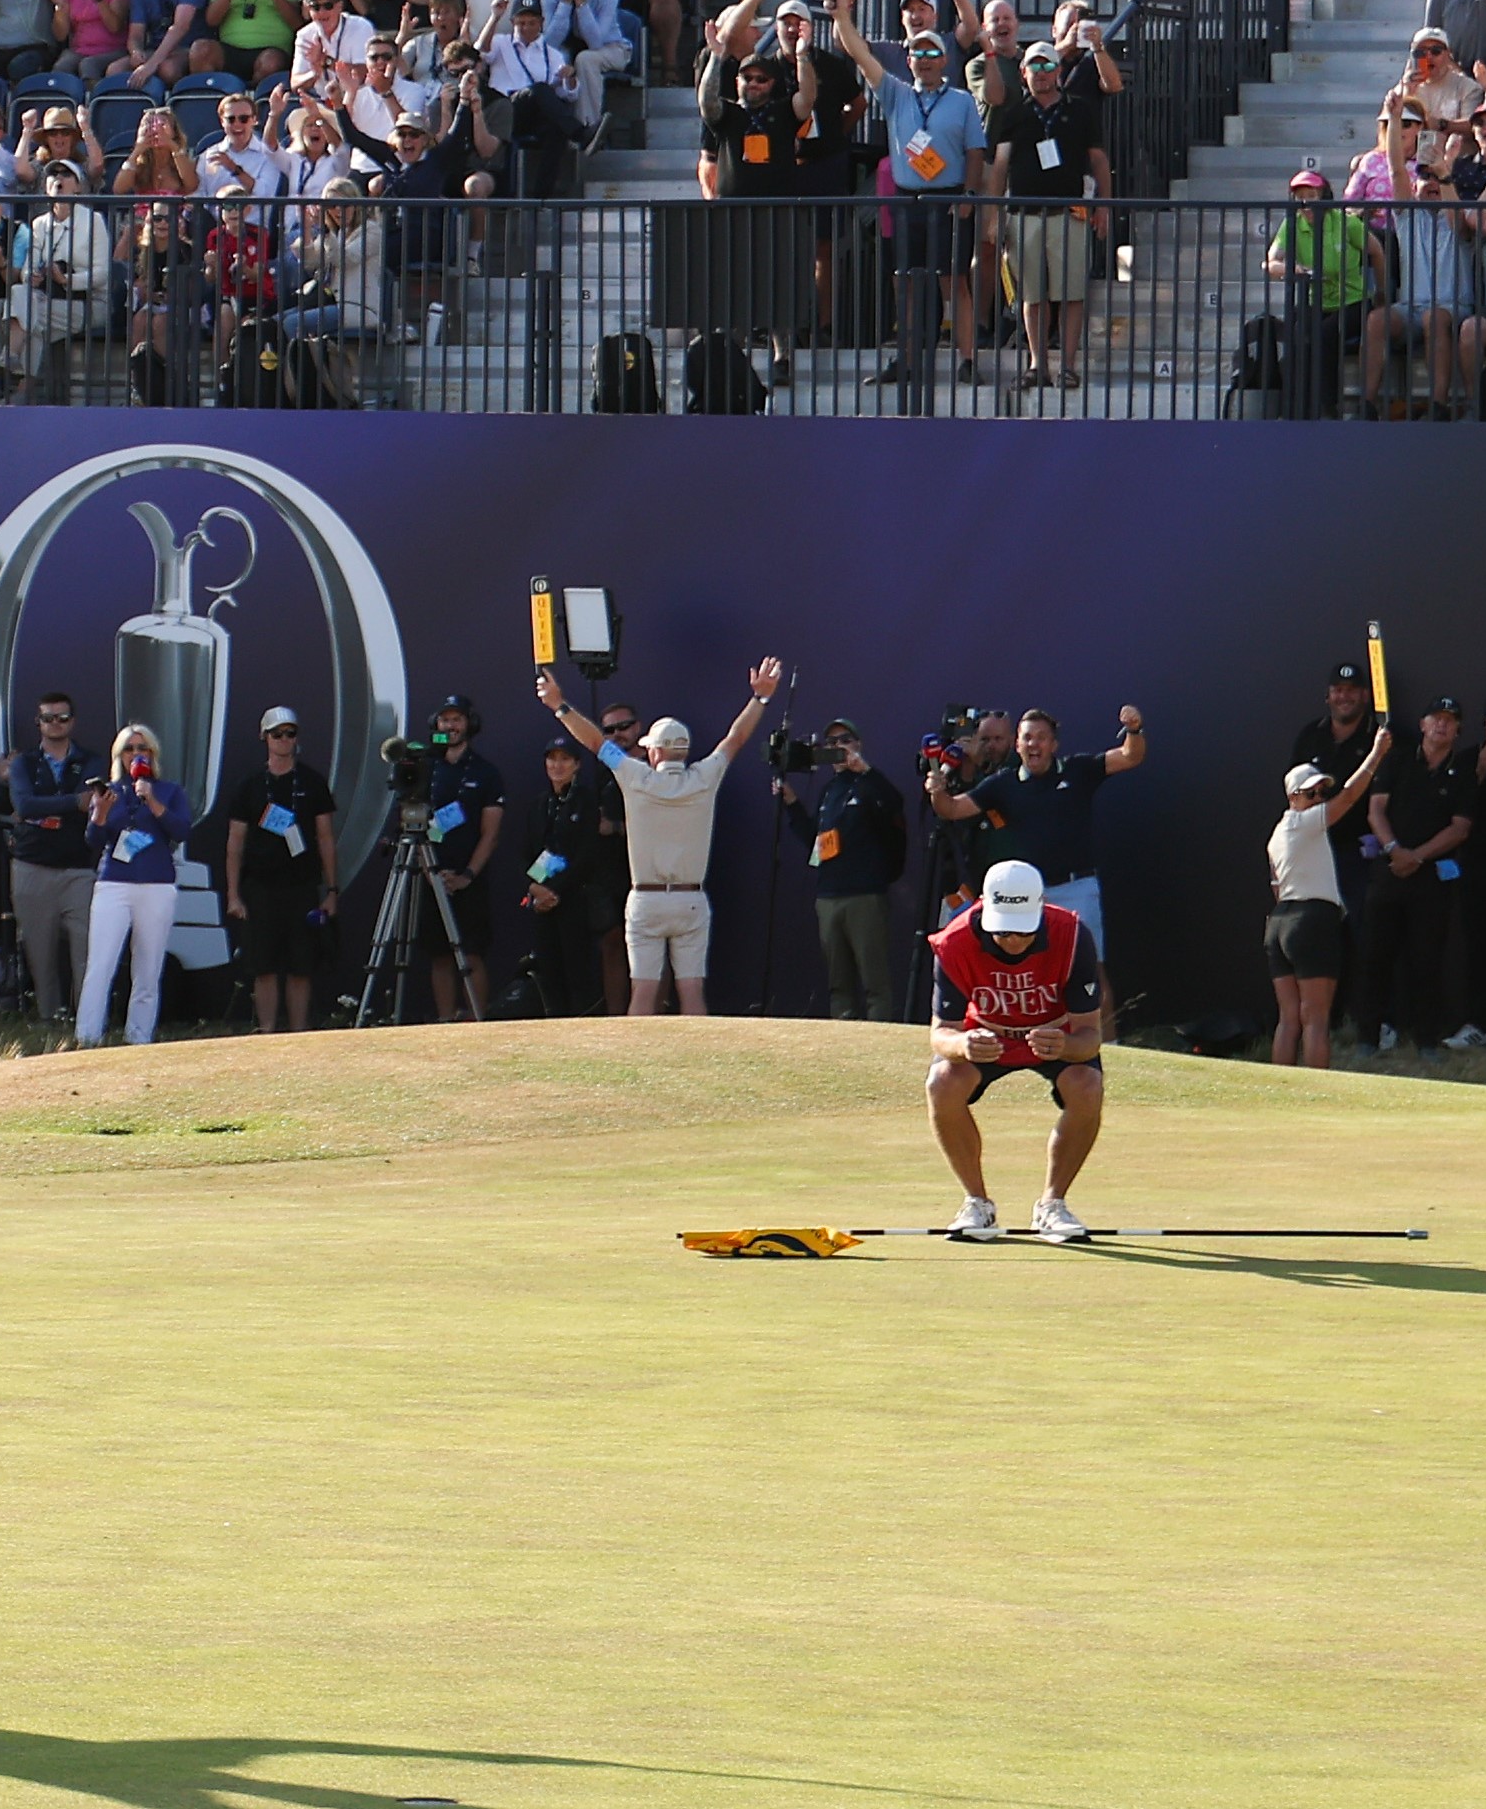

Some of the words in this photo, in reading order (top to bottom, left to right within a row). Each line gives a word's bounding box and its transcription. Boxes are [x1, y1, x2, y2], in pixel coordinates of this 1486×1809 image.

[1307, 158, 1316, 168] D
[1160, 363, 1170, 374] A
[993, 891, 1029, 905] SRIXON
[990, 971, 1036, 990] THE
[971, 983, 1059, 1016] OPEN
